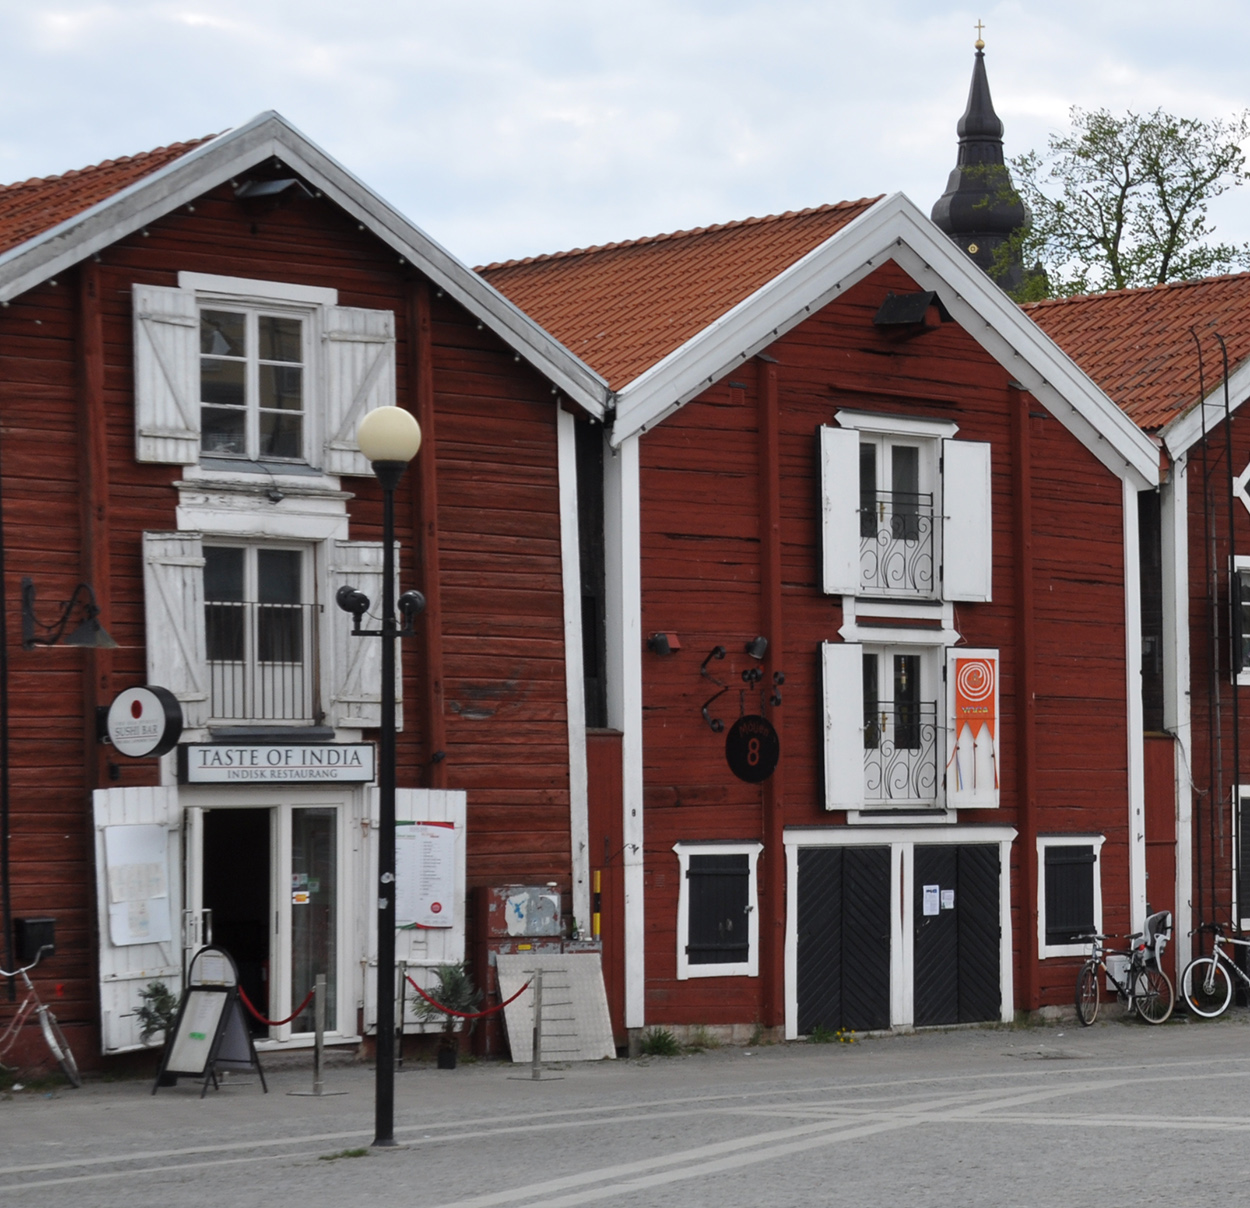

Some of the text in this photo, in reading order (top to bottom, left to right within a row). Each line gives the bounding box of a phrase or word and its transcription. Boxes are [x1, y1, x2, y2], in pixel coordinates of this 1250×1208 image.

[115, 724, 158, 737] SUSHI BAR
[199, 748, 362, 766] TASTE OF INDIA
[747, 737, 761, 766] 8
[227, 769, 338, 779] INDISK RESTAURANG
